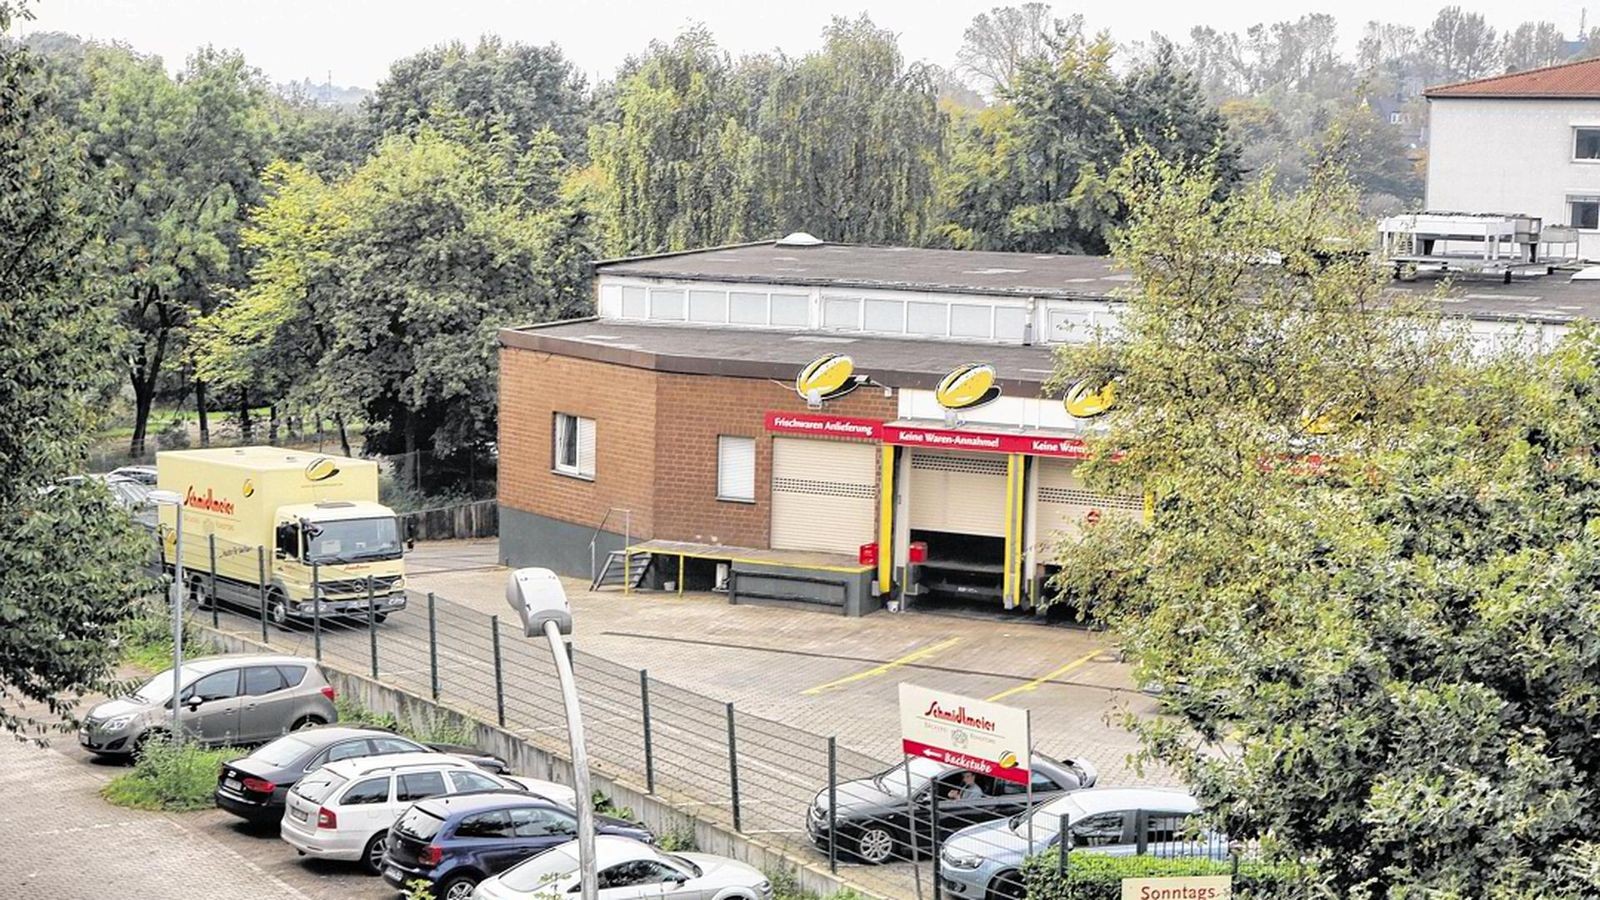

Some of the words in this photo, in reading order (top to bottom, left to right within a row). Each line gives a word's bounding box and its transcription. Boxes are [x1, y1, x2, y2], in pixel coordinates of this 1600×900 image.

[774, 417, 823, 429] Frischwaren
[824, 421, 874, 436] Anlieferung
[899, 431, 924, 442] Keine
[1032, 440, 1059, 452] Keine
[944, 752, 993, 773] Backstube
[1140, 886, 1216, 900] Sonntags
